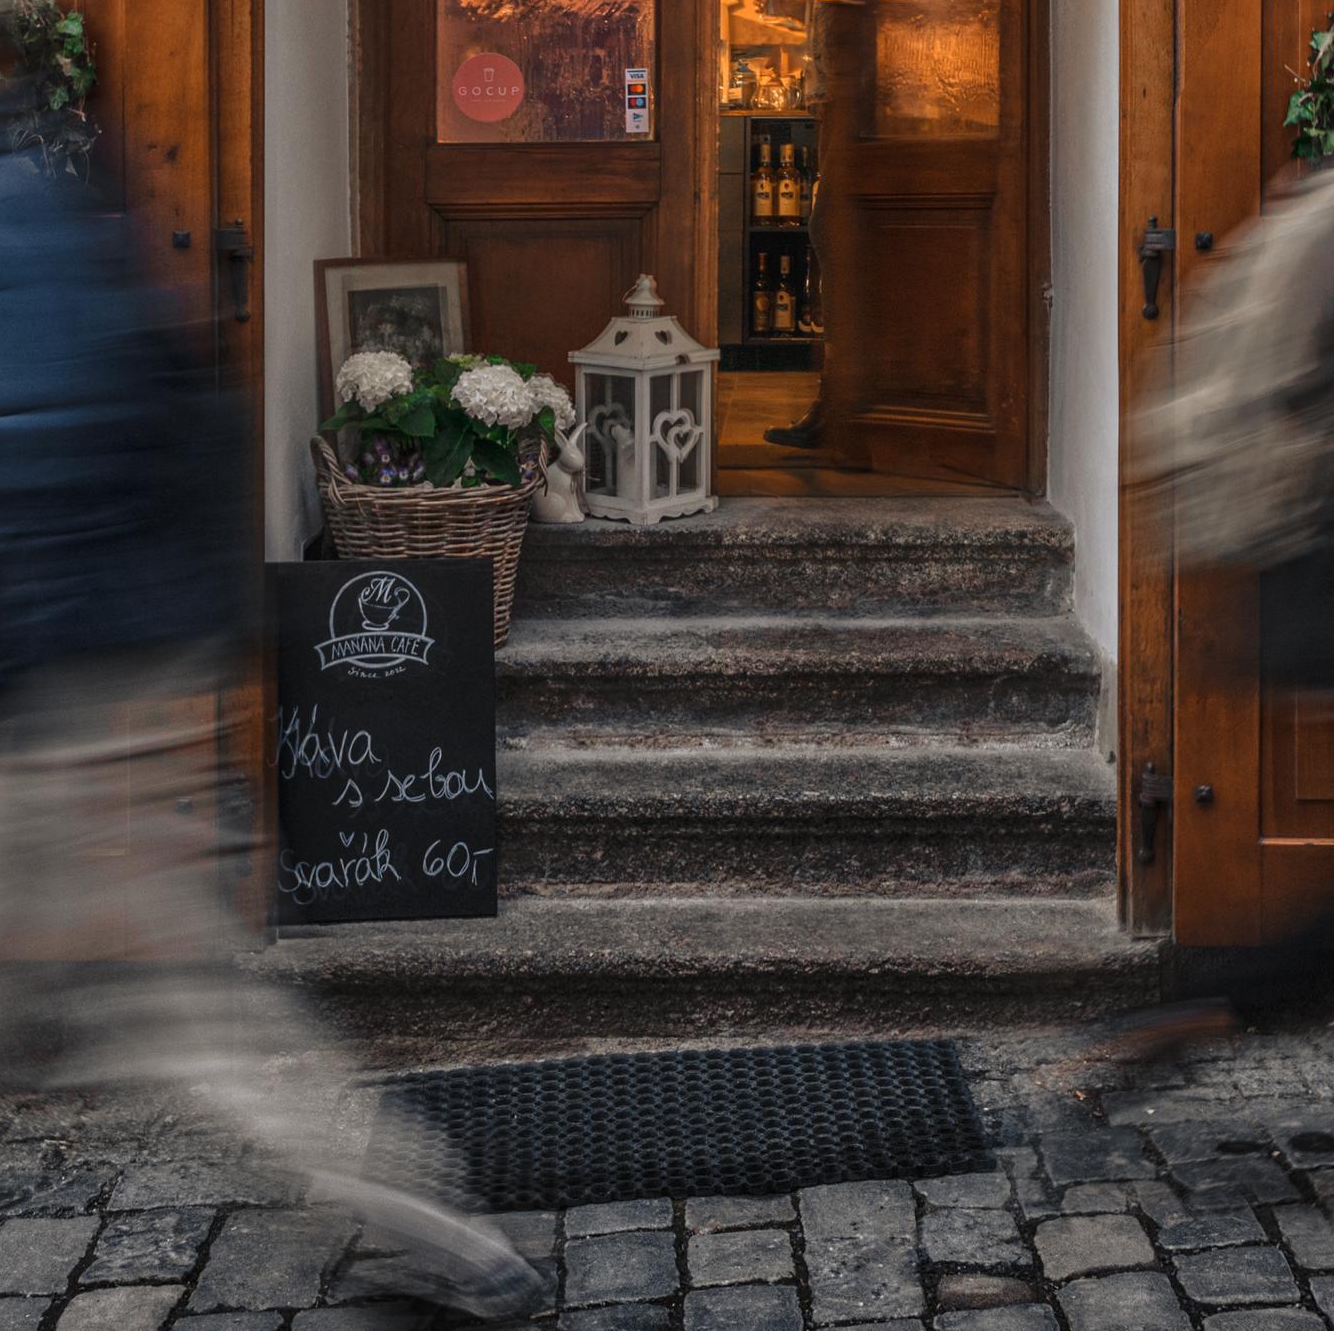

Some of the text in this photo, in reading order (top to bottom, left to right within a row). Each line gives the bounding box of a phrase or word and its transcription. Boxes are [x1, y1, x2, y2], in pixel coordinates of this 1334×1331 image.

[458, 86, 520, 96] GOCUP
[331, 746, 496, 808] s sebou
